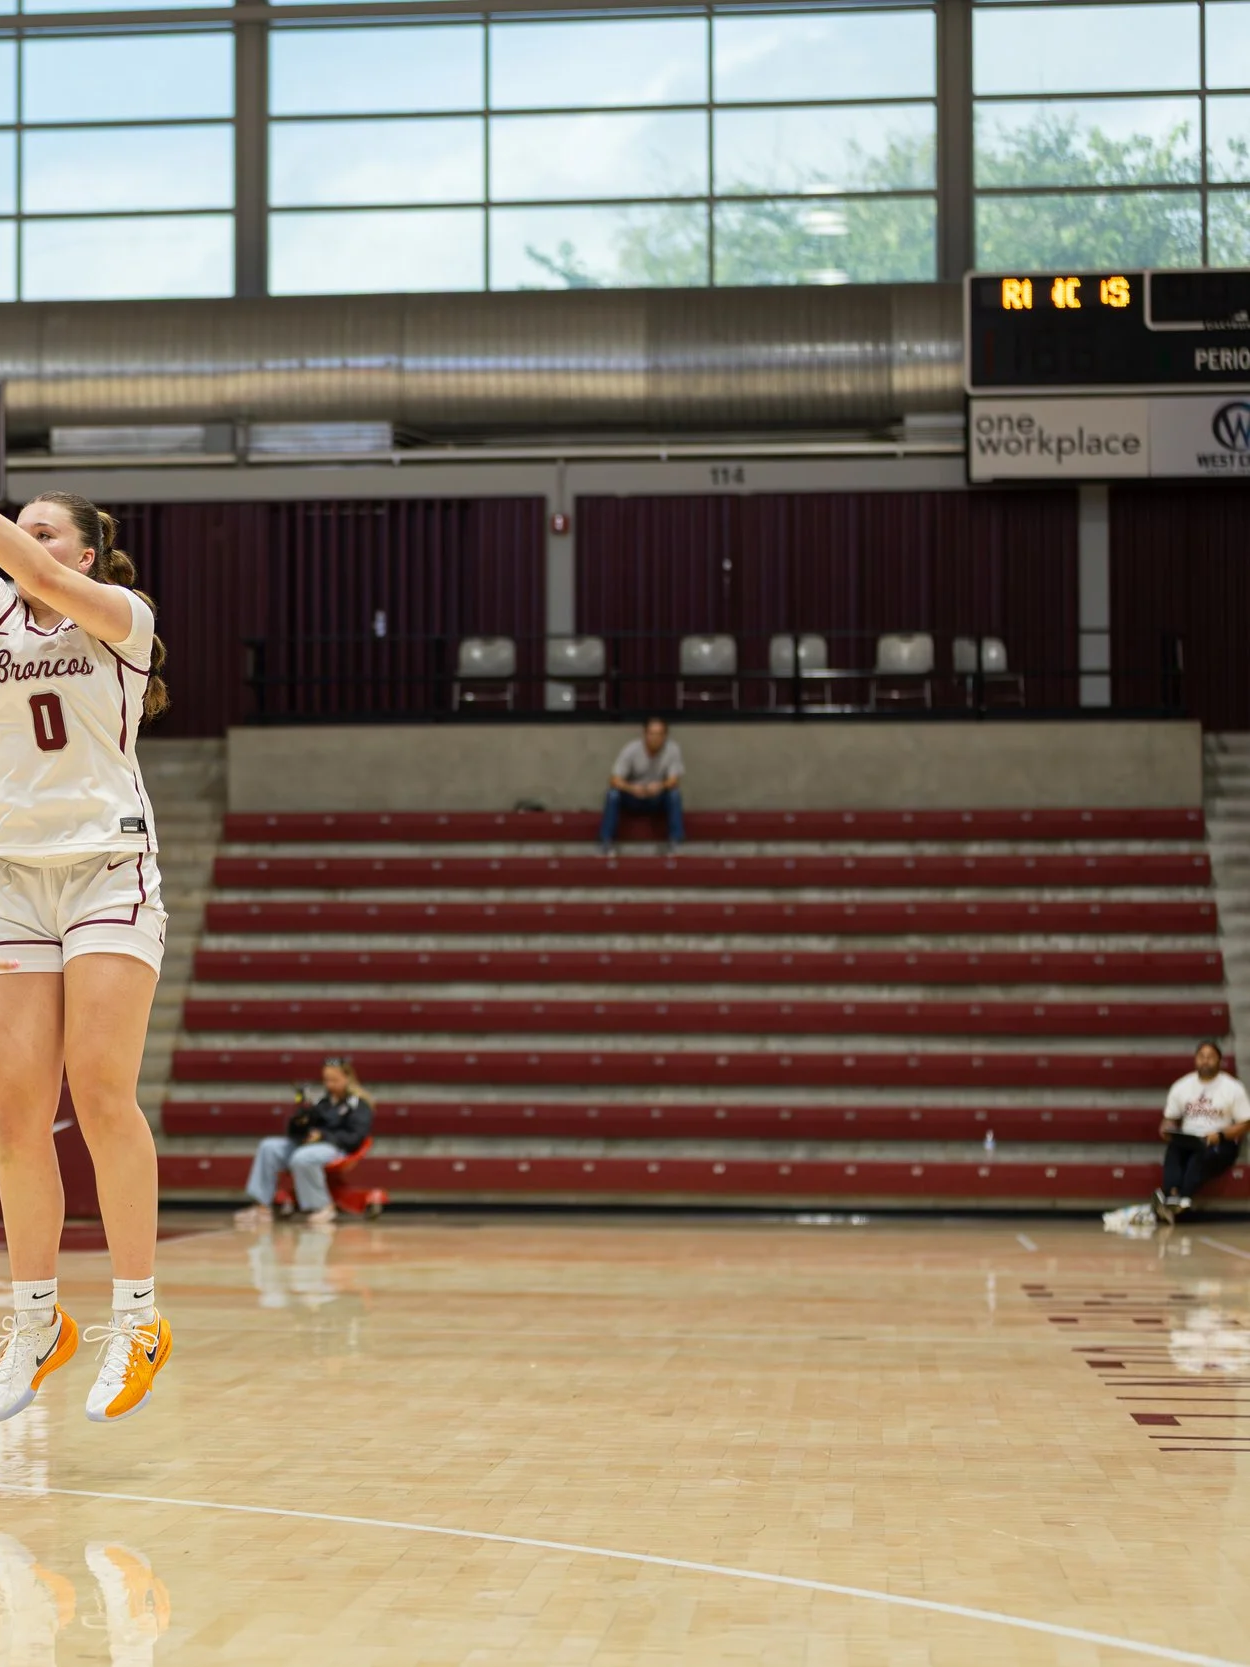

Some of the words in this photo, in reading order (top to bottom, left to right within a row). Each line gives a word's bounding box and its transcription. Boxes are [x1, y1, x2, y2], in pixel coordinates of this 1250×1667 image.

[976, 413, 1035, 435] one
[976, 427, 1142, 464] workplace
[710, 465, 745, 486] 114
[28, 691, 69, 752] 0
